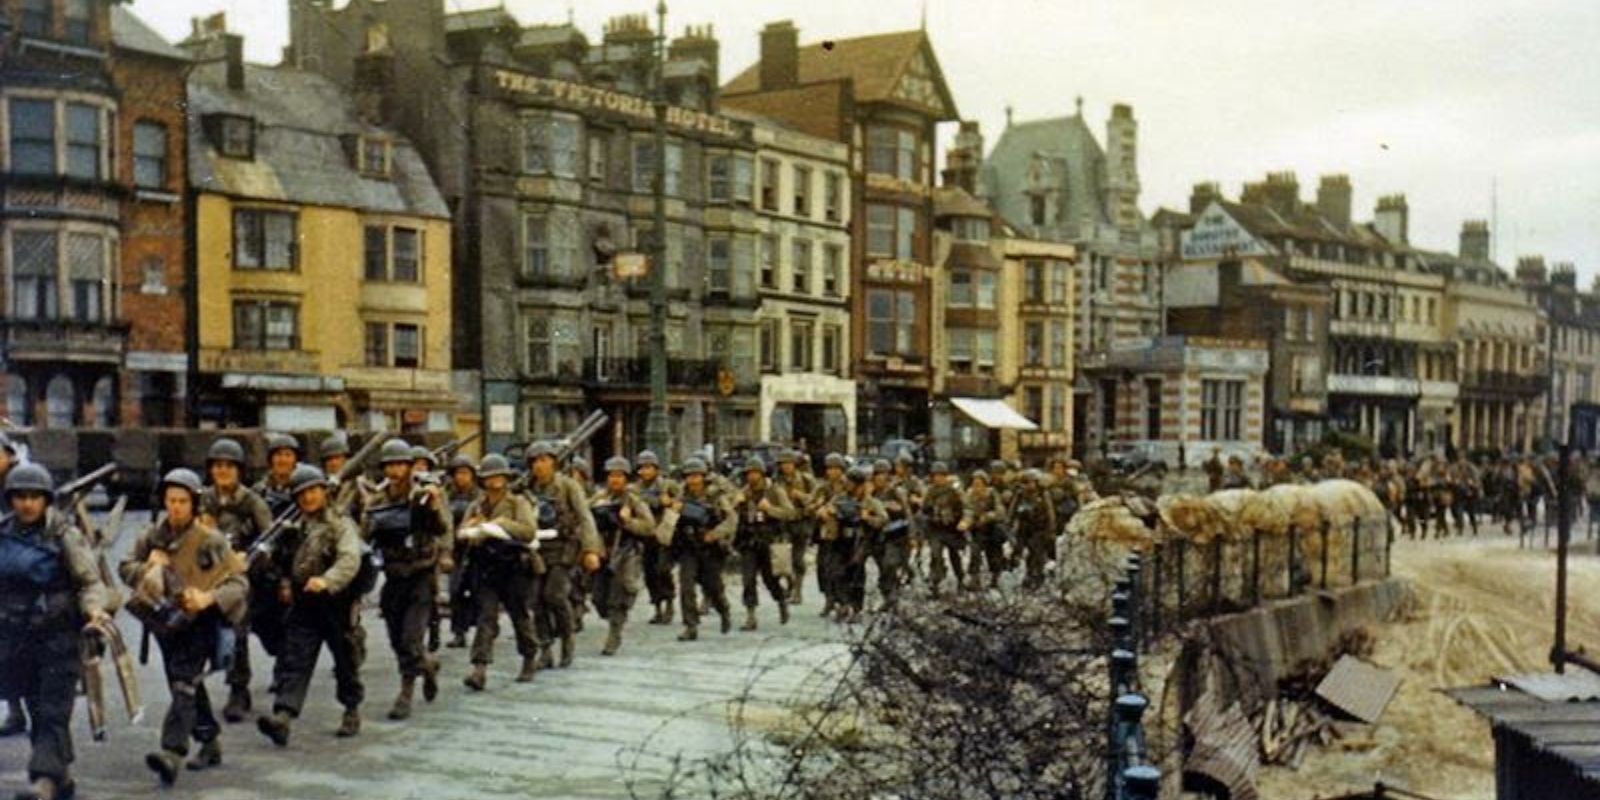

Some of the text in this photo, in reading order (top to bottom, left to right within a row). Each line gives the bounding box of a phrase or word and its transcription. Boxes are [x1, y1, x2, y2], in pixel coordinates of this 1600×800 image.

[496, 70, 736, 136] THE VICTORIA HOTEL
